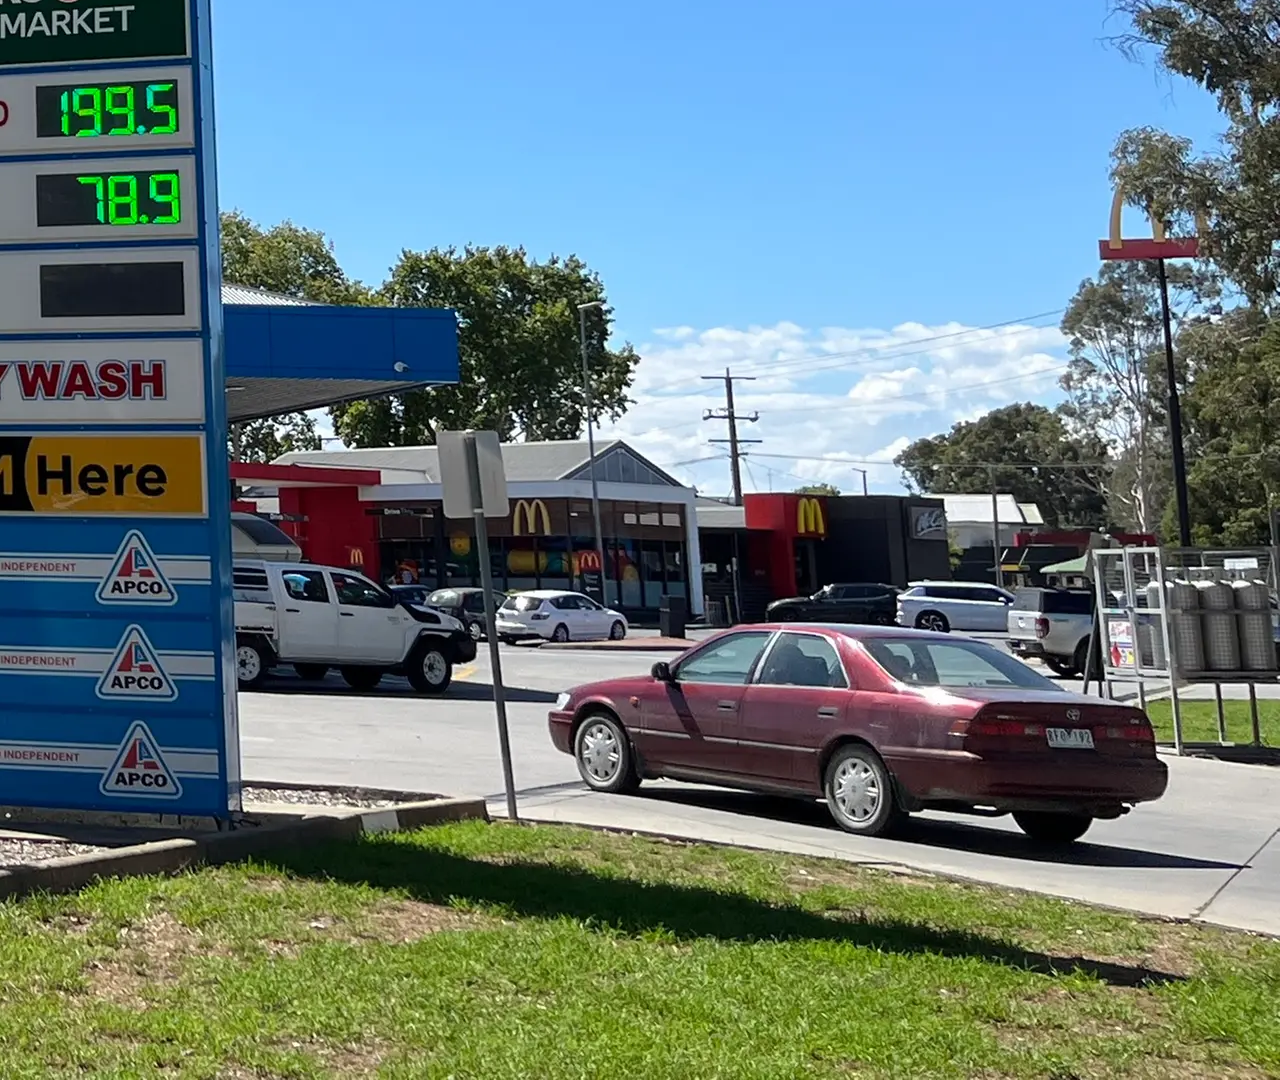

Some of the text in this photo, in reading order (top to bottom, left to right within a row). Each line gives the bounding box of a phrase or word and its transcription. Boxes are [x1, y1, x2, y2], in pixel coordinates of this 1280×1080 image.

[59, 83, 177, 137] 199.5
[75, 173, 180, 225] 78.9
[36, 454, 168, 498] Here
[0, 561, 77, 573] INDEPENDENT
[110, 580, 164, 595] APCO
[0, 655, 77, 667] INDEPENDENT
[110, 675, 164, 690] APCO
[3, 749, 80, 762] INDEPENDENT
[114, 772, 168, 788] APCO
